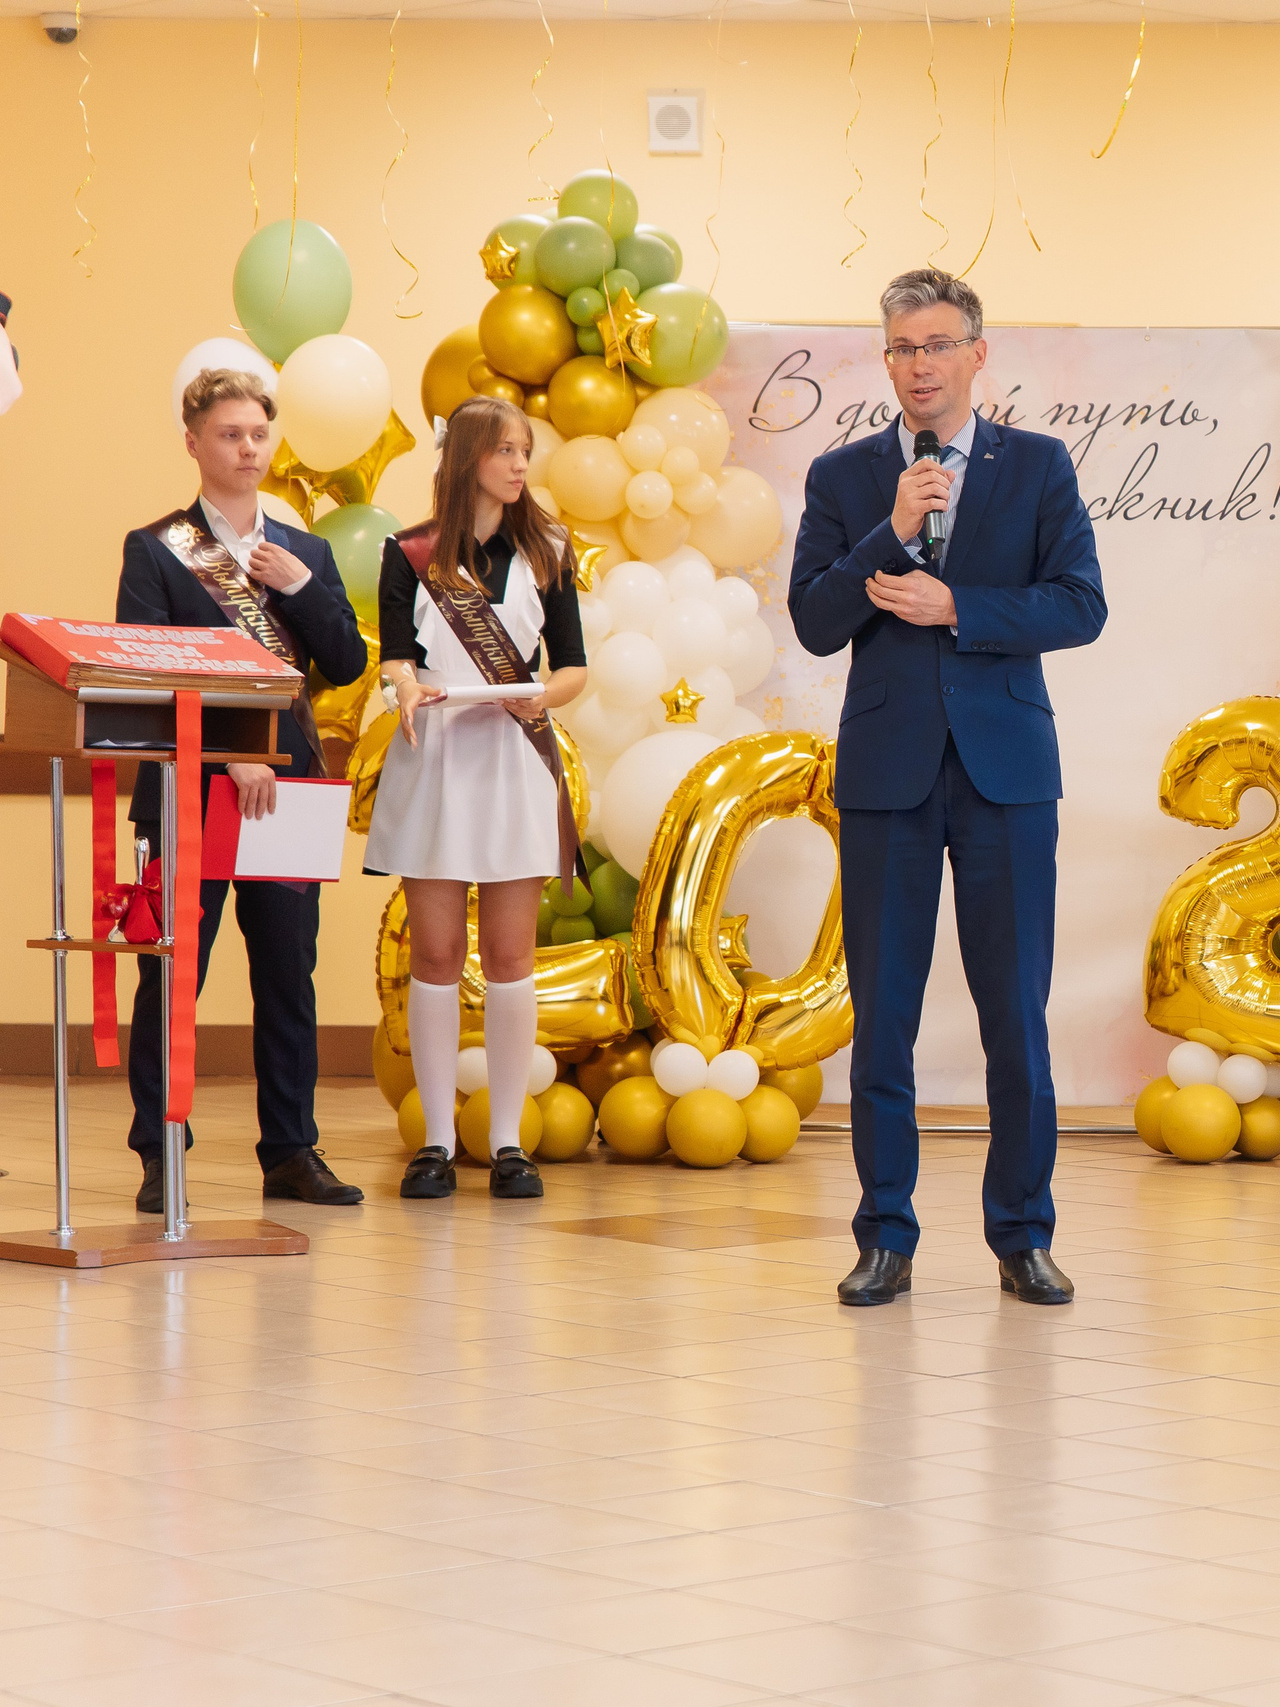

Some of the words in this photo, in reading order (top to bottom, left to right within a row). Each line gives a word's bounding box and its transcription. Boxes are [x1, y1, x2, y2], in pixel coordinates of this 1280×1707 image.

[749, 349, 822, 433] В
[1040, 399, 1219, 472] путь,
[447, 588, 520, 684] Выпускниц
